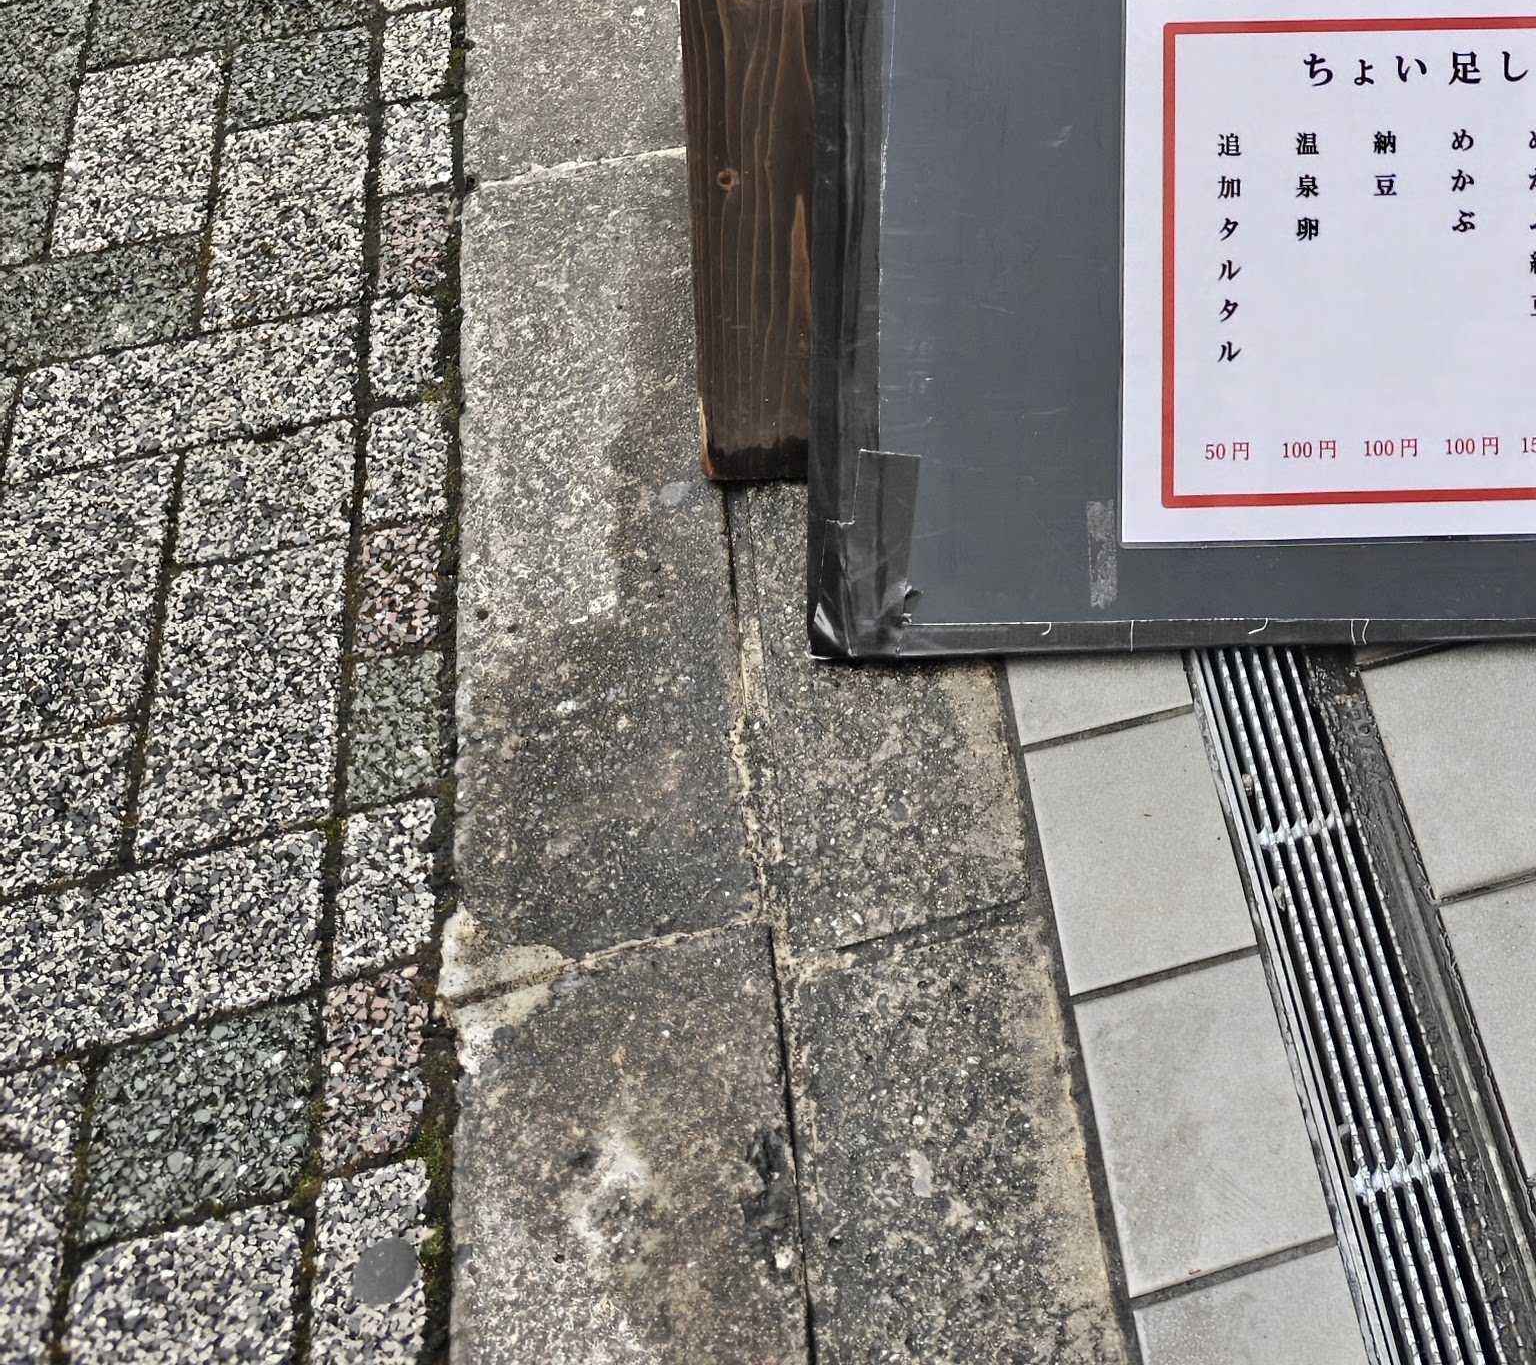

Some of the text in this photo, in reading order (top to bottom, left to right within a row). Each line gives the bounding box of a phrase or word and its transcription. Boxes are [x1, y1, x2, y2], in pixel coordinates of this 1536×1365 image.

[1296, 131, 1320, 241] 温泉卵
[1373, 130, 1398, 198] 納豆
[1450, 128, 1477, 235] めかぶ
[1217, 132, 1243, 365] 追加タルタル
